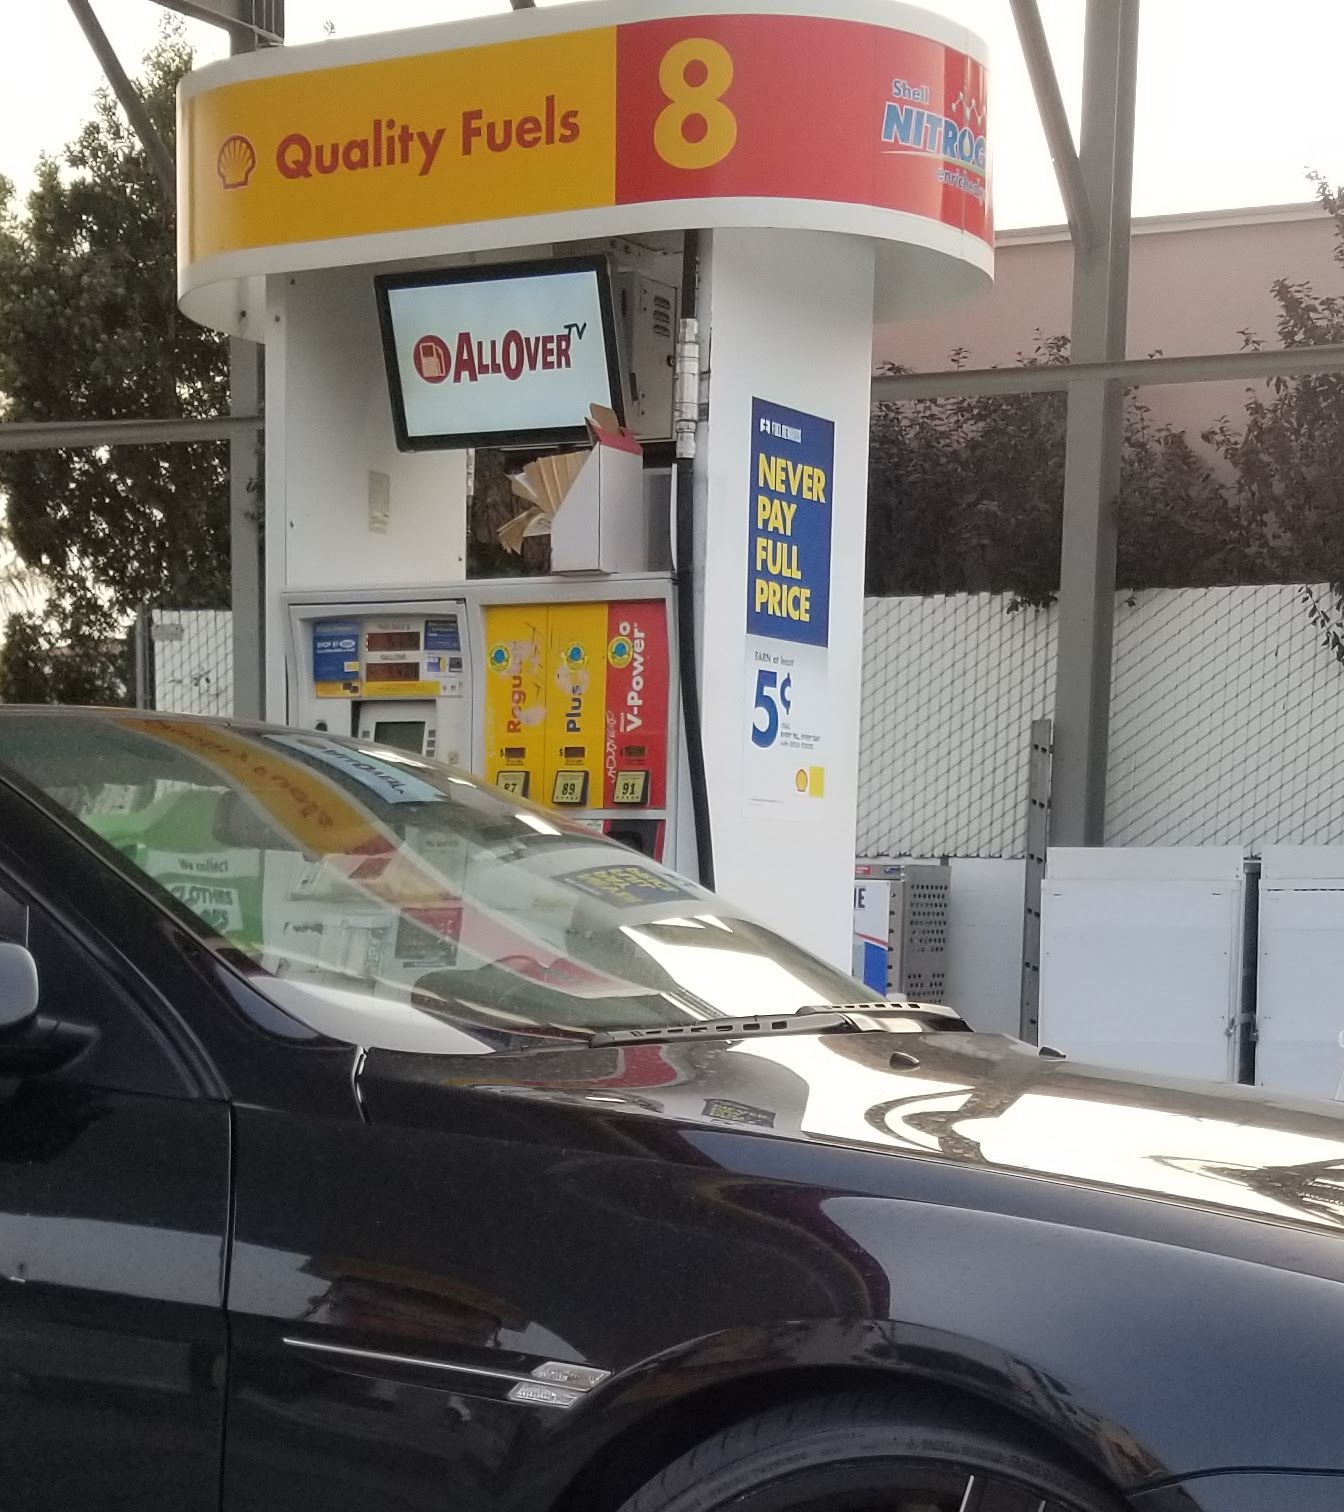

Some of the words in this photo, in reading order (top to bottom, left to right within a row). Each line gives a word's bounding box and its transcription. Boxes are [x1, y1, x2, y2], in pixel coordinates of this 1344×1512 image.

[654, 38, 737, 169] 8
[892, 78, 929, 104] Shell
[276, 118, 446, 179] Quality
[462, 94, 581, 156] Fuels
[564, 322, 587, 340] TV
[758, 452, 826, 503] NEVER
[757, 494, 797, 536] PAY
[756, 537, 802, 580] FULL
[755, 578, 811, 622] PRICE
[626, 622, 645, 733] V-Power
[565, 684, 582, 733] Plus
[751, 669, 792, 748] 5¢
[561, 782, 576, 796] 89
[622, 782, 636, 796] 91
